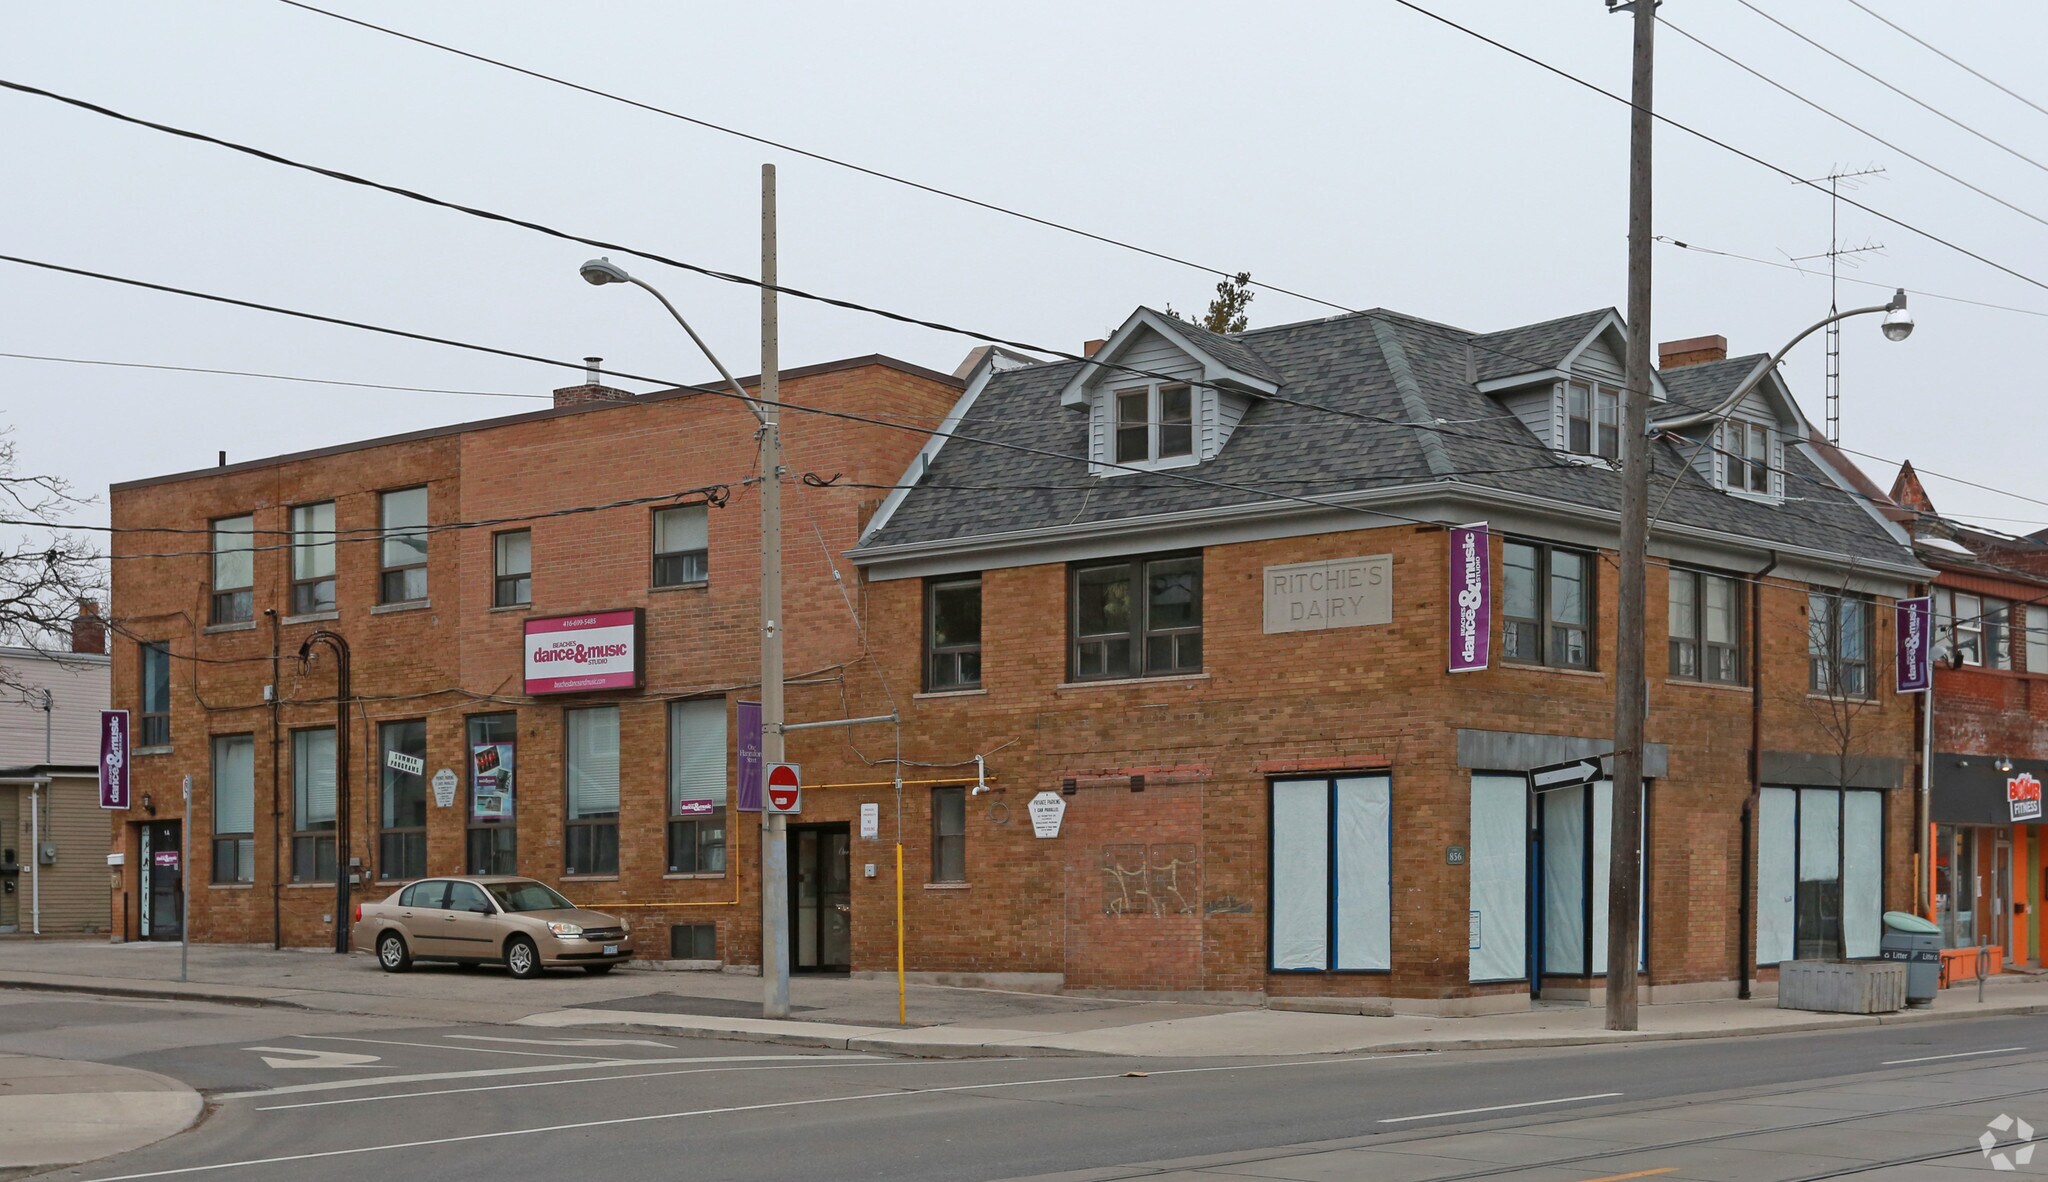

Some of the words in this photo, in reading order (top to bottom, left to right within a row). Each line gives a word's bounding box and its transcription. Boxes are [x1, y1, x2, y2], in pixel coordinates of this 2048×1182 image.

[1272, 566, 1383, 596] RITCHIE'S
[1458, 532, 1482, 663] dance&music
[1289, 595, 1365, 622] DAIRY
[562, 618, 597, 628] 416-699-5485
[552, 641, 577, 649] BEACHES
[533, 643, 627, 663] dance&music
[587, 658, 608, 666] STUDIO
[394, 753, 418, 765] SUMMER
[390, 760, 420, 774] PROGRAMS
[2009, 778, 2041, 801] BOMB
[2014, 800, 2038, 815] FITNESS
[1449, 852, 1462, 861] 856
[1892, 951, 1908, 960] Litter
